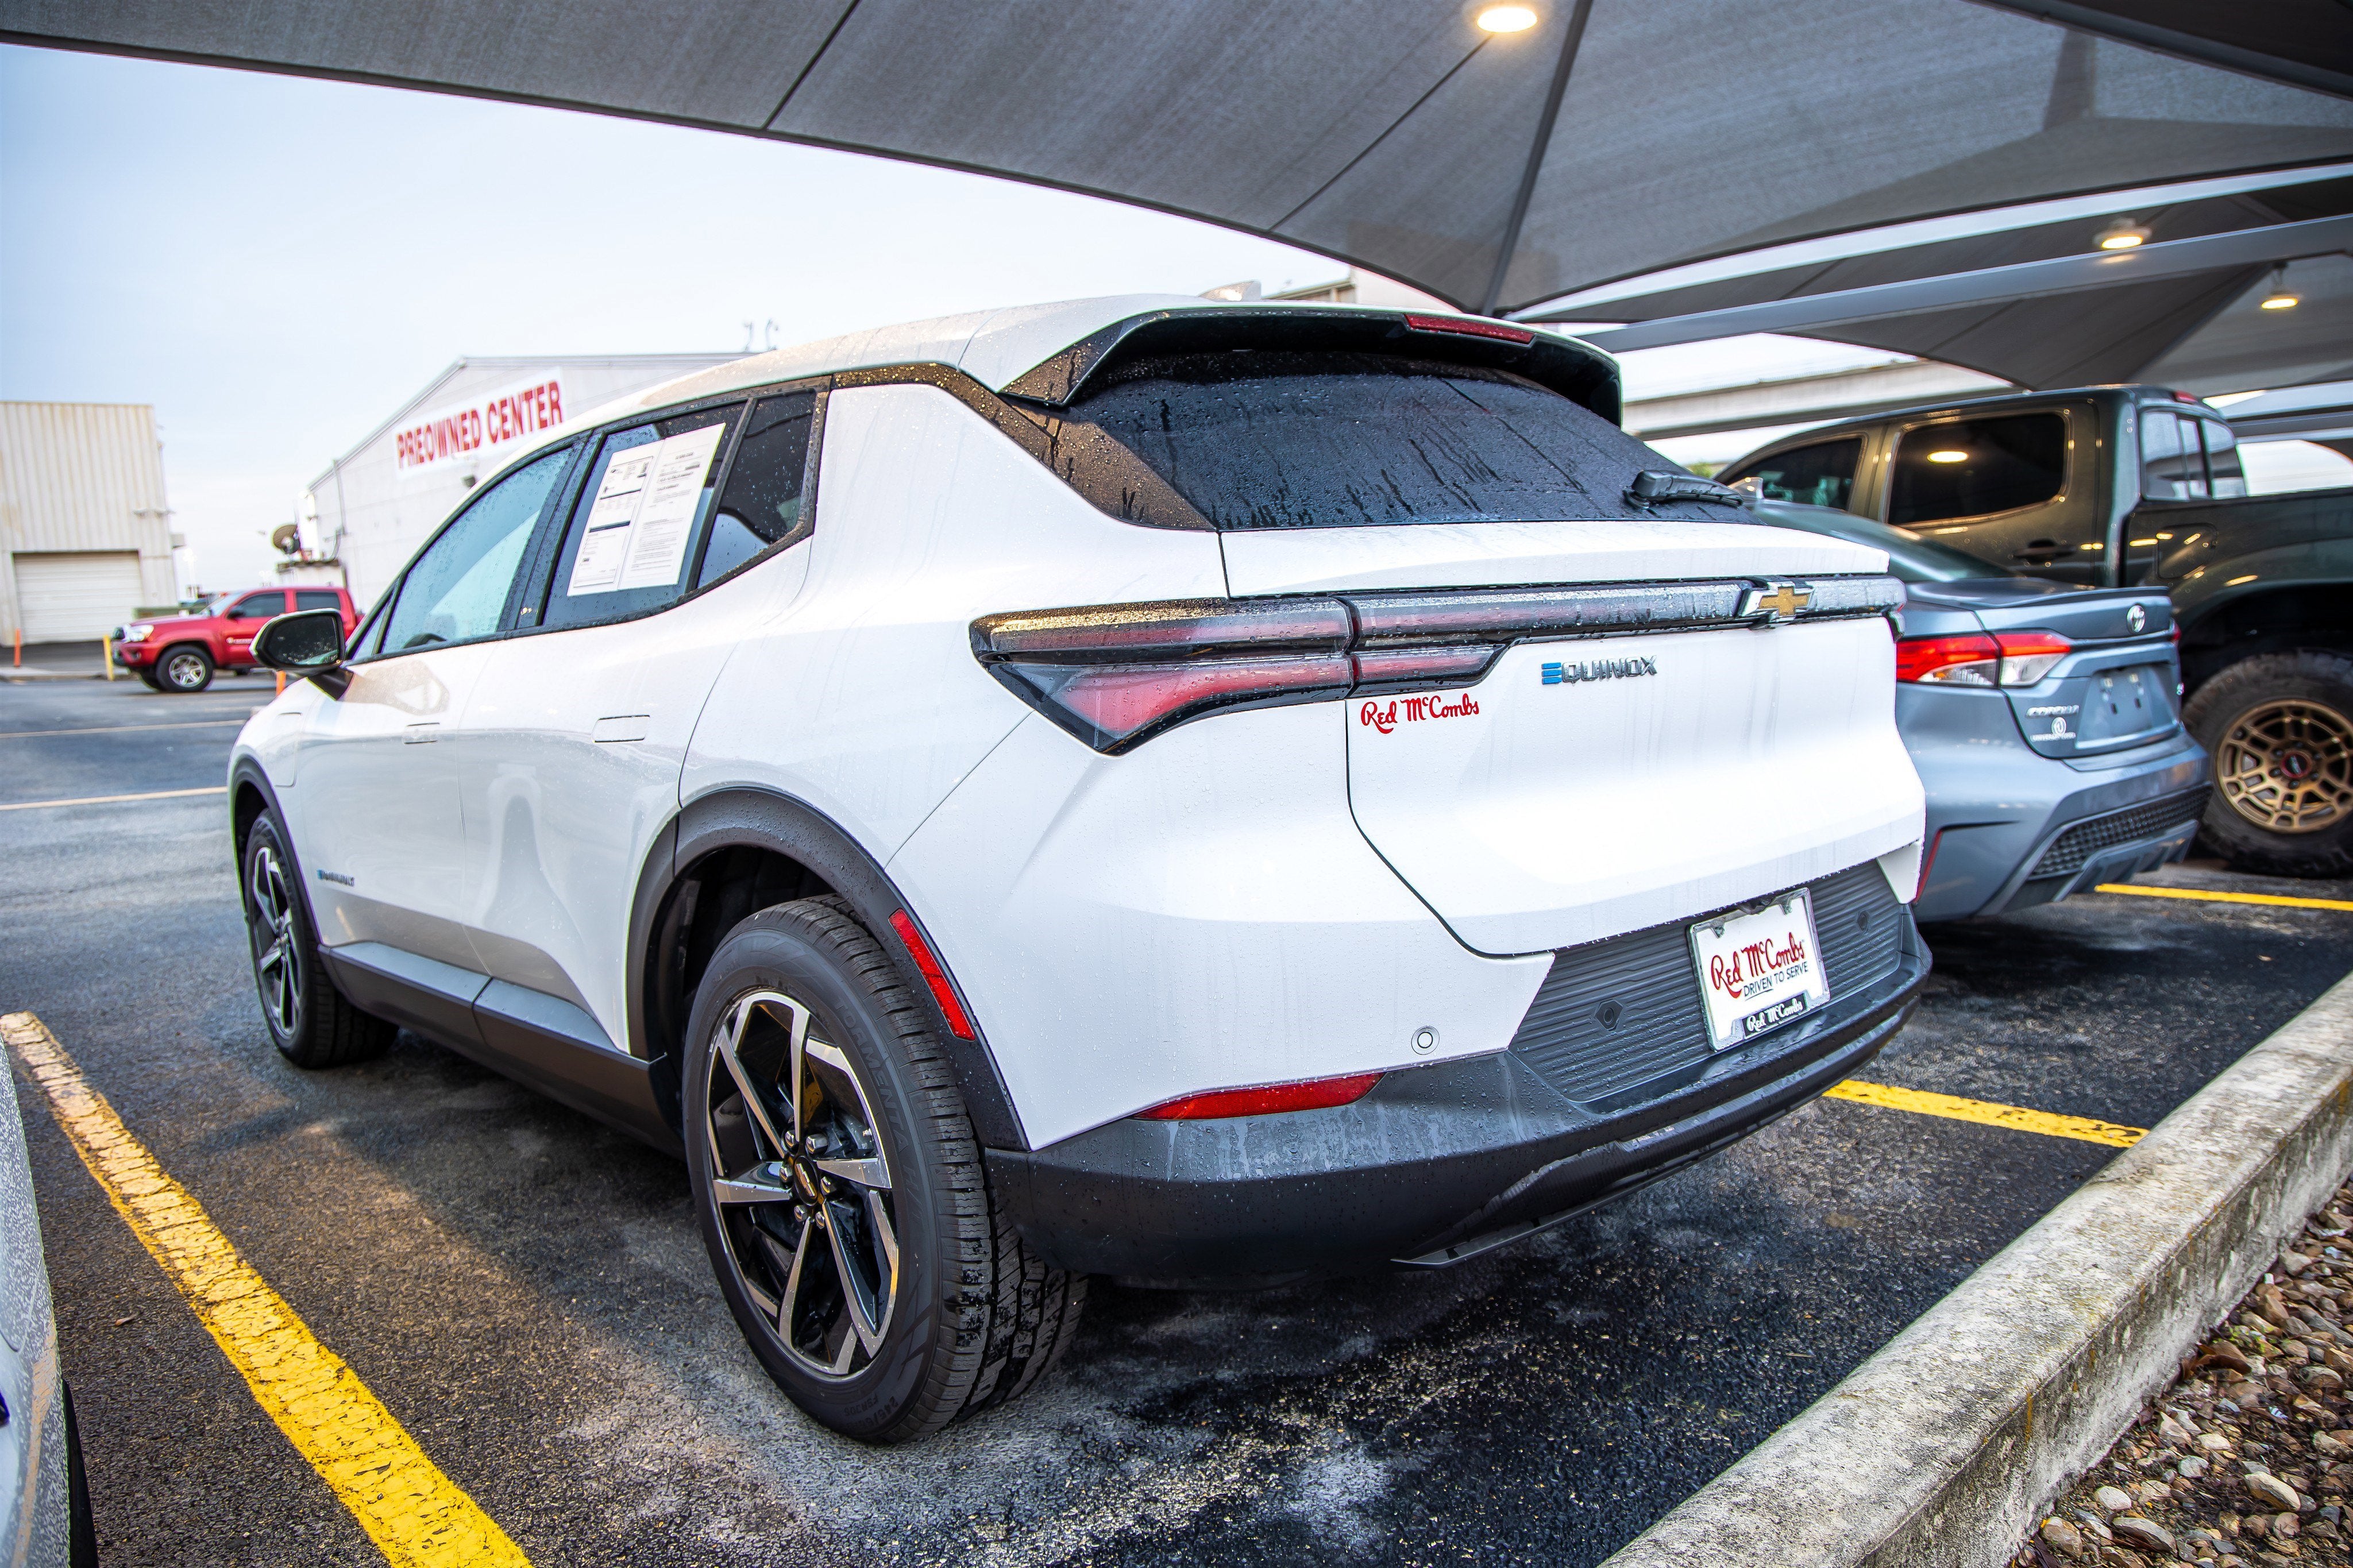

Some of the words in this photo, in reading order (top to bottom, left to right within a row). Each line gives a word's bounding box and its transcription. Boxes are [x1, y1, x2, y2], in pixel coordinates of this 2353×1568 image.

[396, 408, 481, 469] PREOWNED
[487, 380, 562, 446] CENTER
[1541, 655, 1658, 685] EQUINOX
[1361, 701, 1398, 734] Red
[1400, 693, 1479, 721] McCombs
[1711, 951, 1743, 998] Red
[1741, 932, 1805, 978] McCombs
[1743, 976, 1773, 998] DRIVEN
[1774, 971, 1785, 984] TO
[1787, 961, 1809, 980] SERVE
[1746, 1012, 1766, 1032] Red
[1765, 998, 1803, 1024] McCombs
[835, 1001, 907, 1153] TORMENTA
